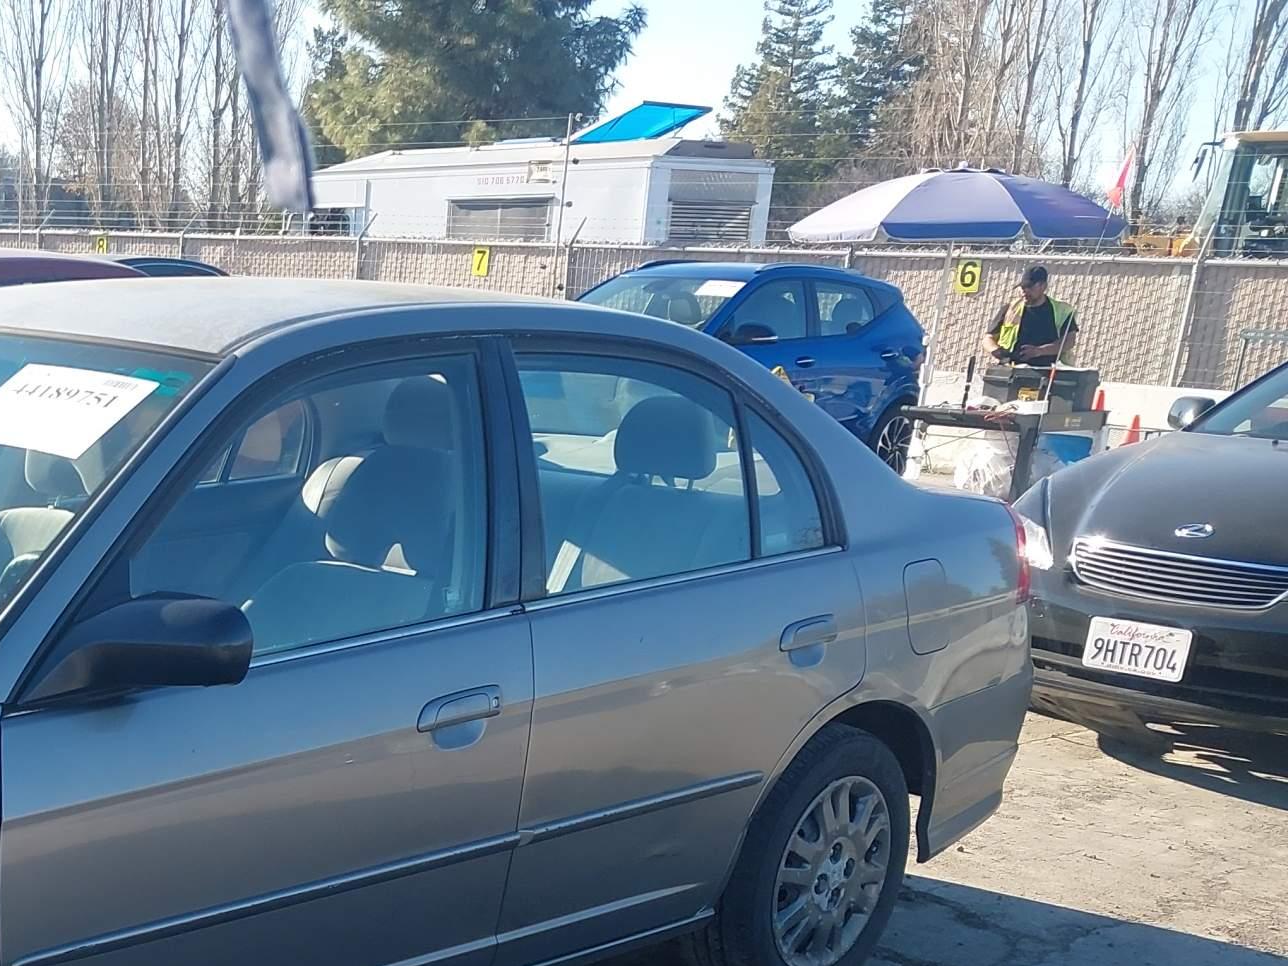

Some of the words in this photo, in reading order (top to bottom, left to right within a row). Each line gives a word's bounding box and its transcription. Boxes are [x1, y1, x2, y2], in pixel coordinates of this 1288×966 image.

[476, 250, 488, 271] 7
[960, 261, 978, 288] 6
[11, 384, 119, 408] 44189751
[1110, 622, 1166, 641] California
[1091, 638, 1177, 673] 9HTR704
